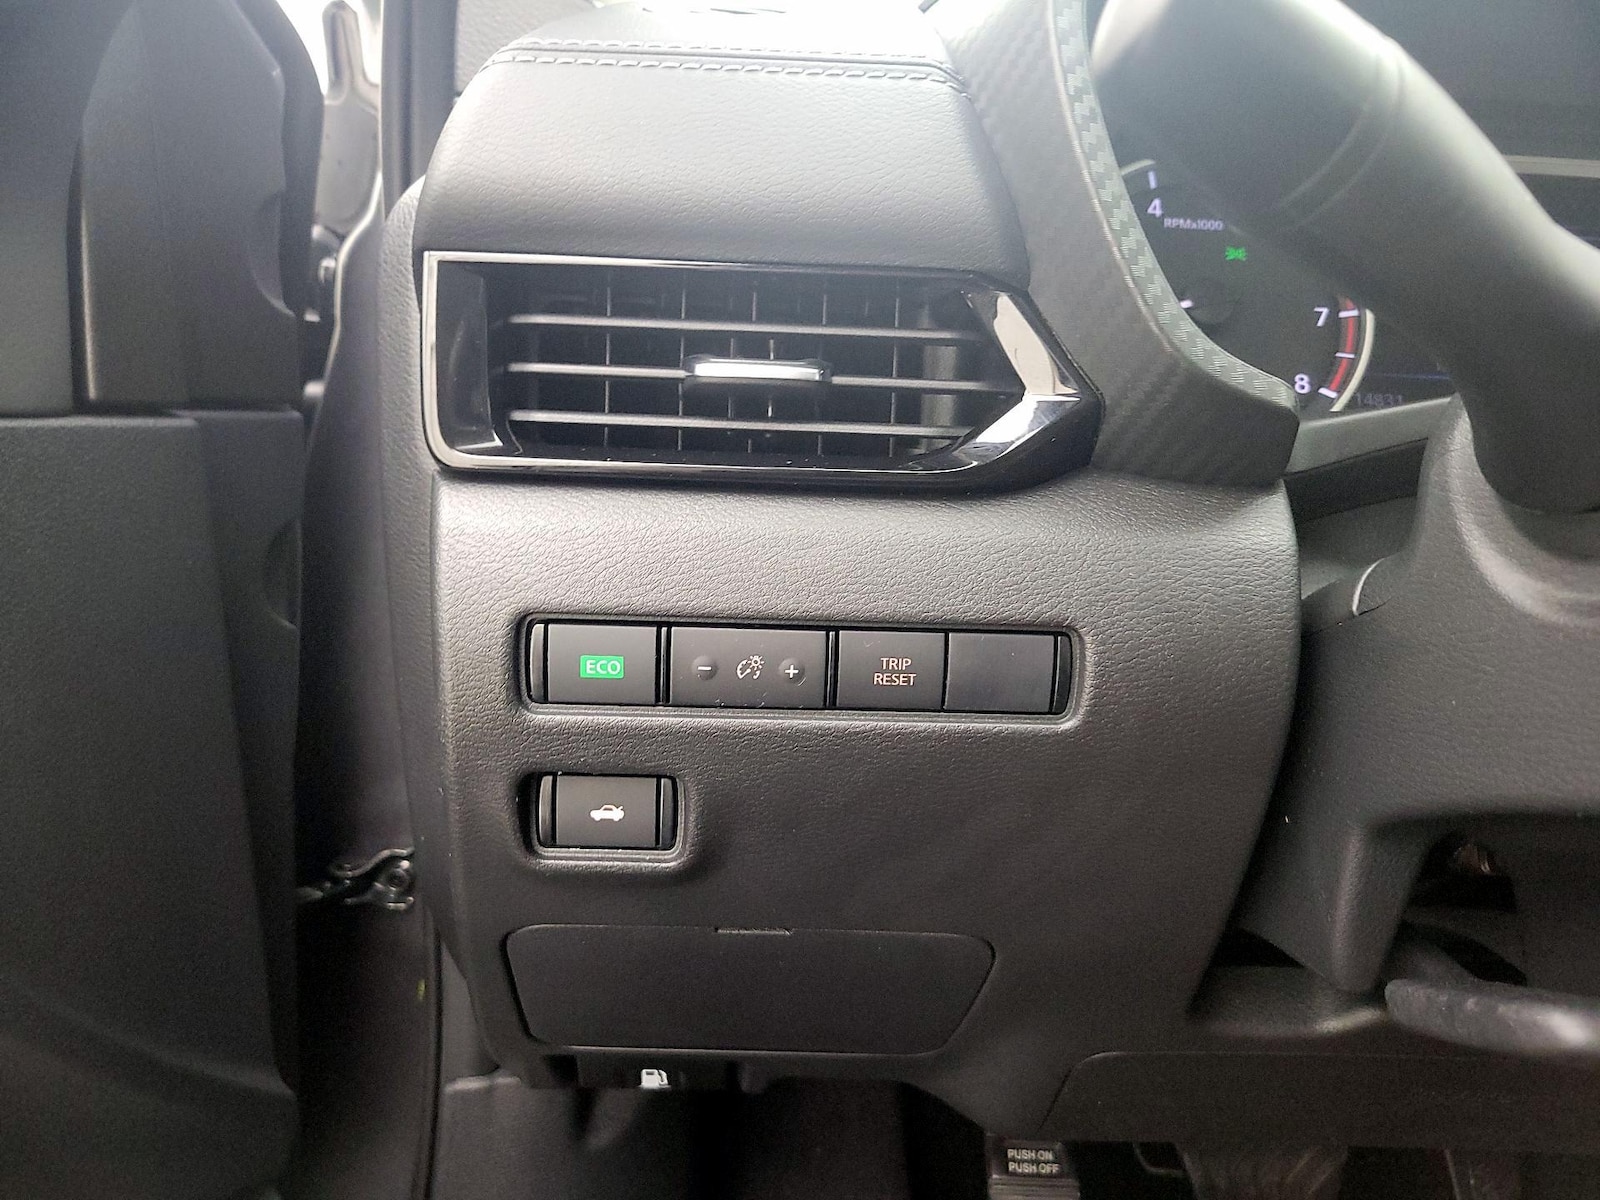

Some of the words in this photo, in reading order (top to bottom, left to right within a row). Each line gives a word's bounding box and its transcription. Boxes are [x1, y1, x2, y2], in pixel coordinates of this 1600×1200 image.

[1147, 197, 1164, 218] 4
[1314, 306, 1330, 327] 7
[1294, 373, 1311, 394] 8
[585, 659, 621, 675] ECO
[879, 656, 912, 672] TRIP
[872, 672, 917, 687] RESET
[1006, 1148, 1036, 1160] PUSH
[1036, 1149, 1054, 1161] ON
[1008, 1161, 1038, 1173] PUSH
[1038, 1163, 1060, 1174] OFF
